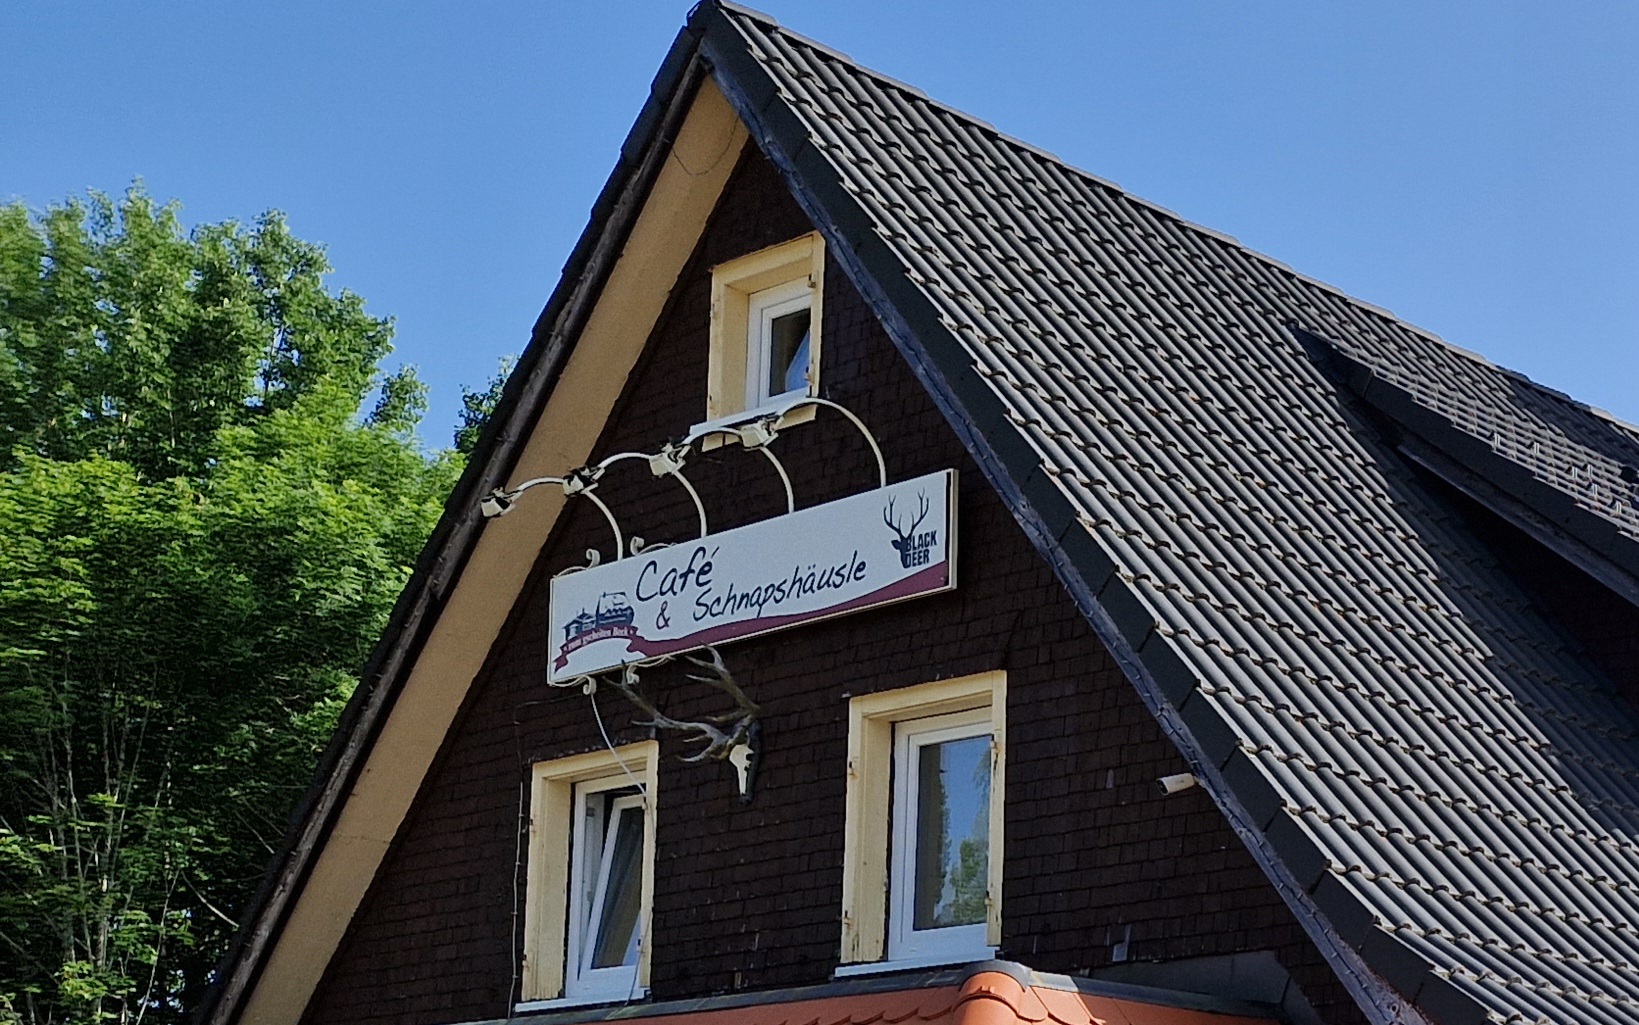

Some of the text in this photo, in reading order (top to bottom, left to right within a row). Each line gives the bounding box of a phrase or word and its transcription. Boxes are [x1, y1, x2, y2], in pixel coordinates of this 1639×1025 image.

[905, 548, 930, 569] DEER
[907, 530, 937, 552] BLACK
[636, 546, 720, 602] Café
[656, 550, 867, 631] & Schnapshäusle
